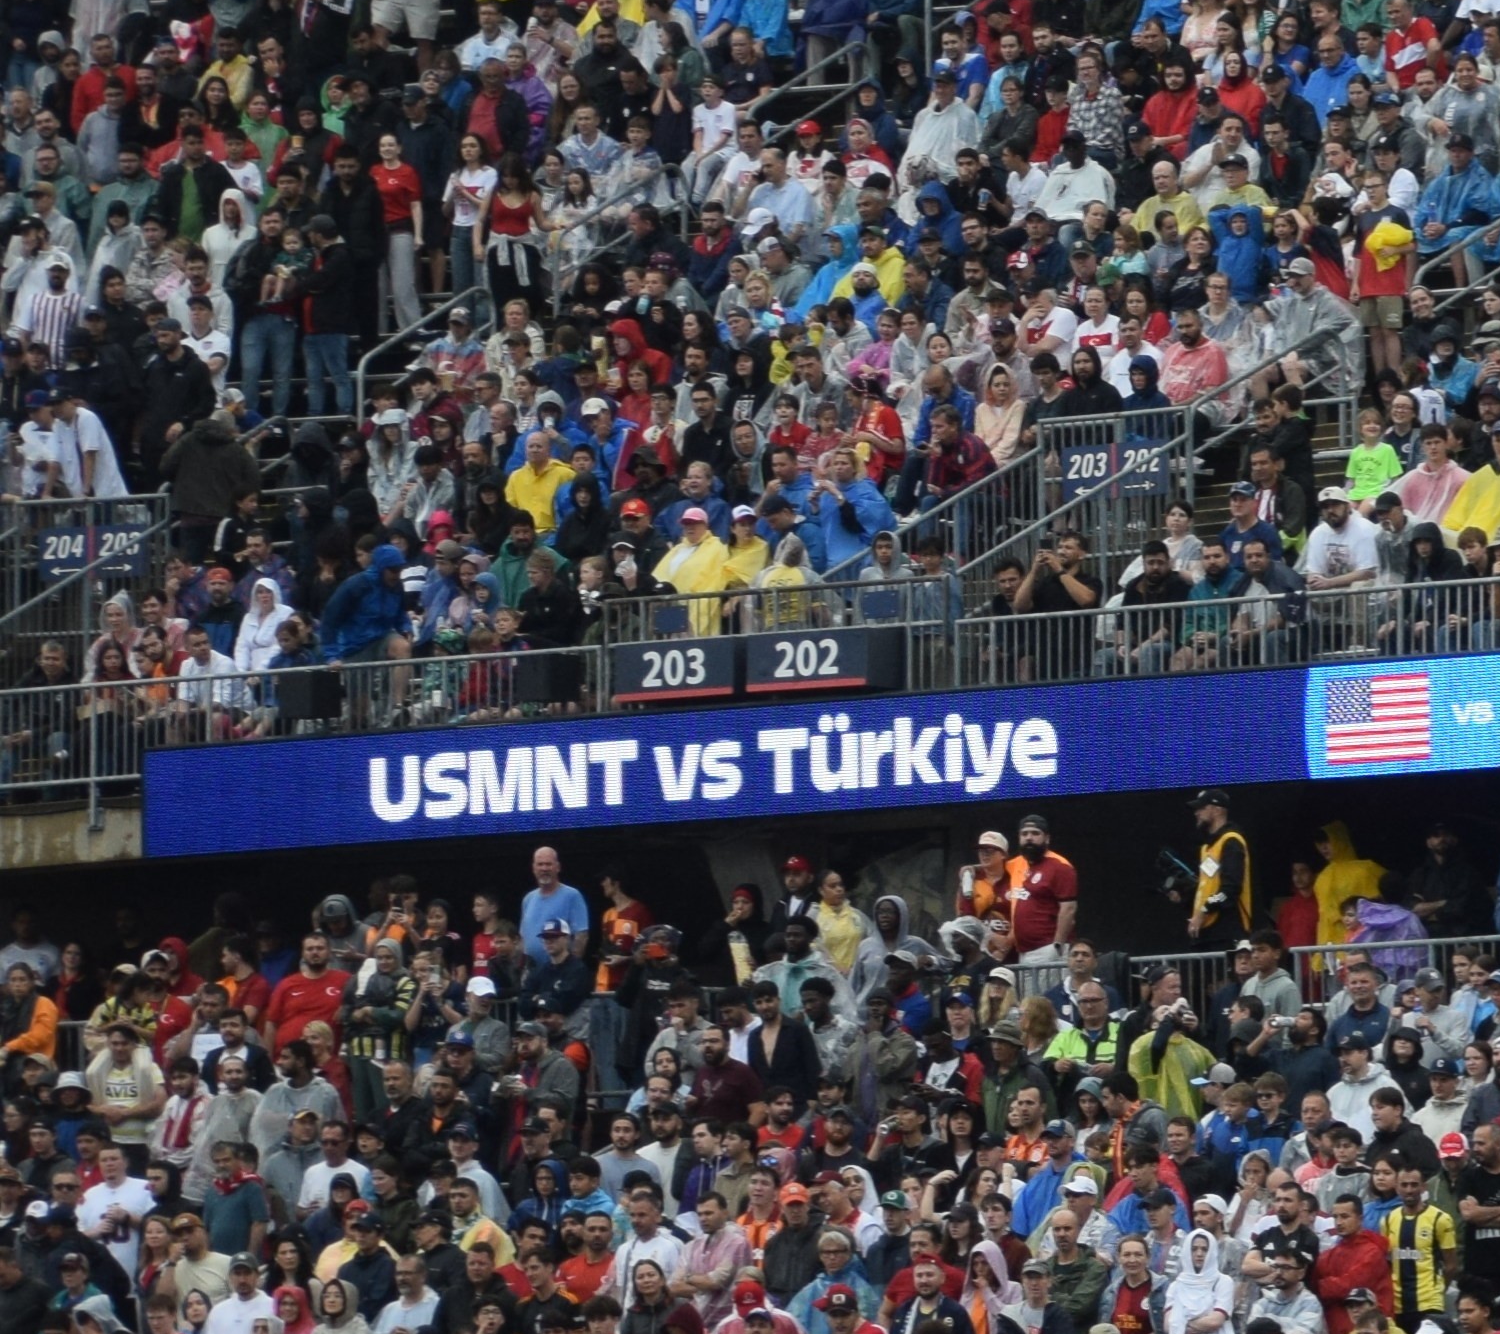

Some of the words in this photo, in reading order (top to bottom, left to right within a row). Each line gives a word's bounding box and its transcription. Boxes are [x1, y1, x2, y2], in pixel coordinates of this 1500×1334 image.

[1066, 452, 1107, 482] 203
[47, 529, 85, 562] 204
[641, 647, 706, 689] 203
[774, 636, 839, 680] 202
[1450, 698, 1495, 725] vs
[368, 740, 638, 822] USMNT
[653, 742, 741, 801] vs
[757, 712, 1058, 794] Türkiye
[105, 1084, 138, 1100] AVIS
